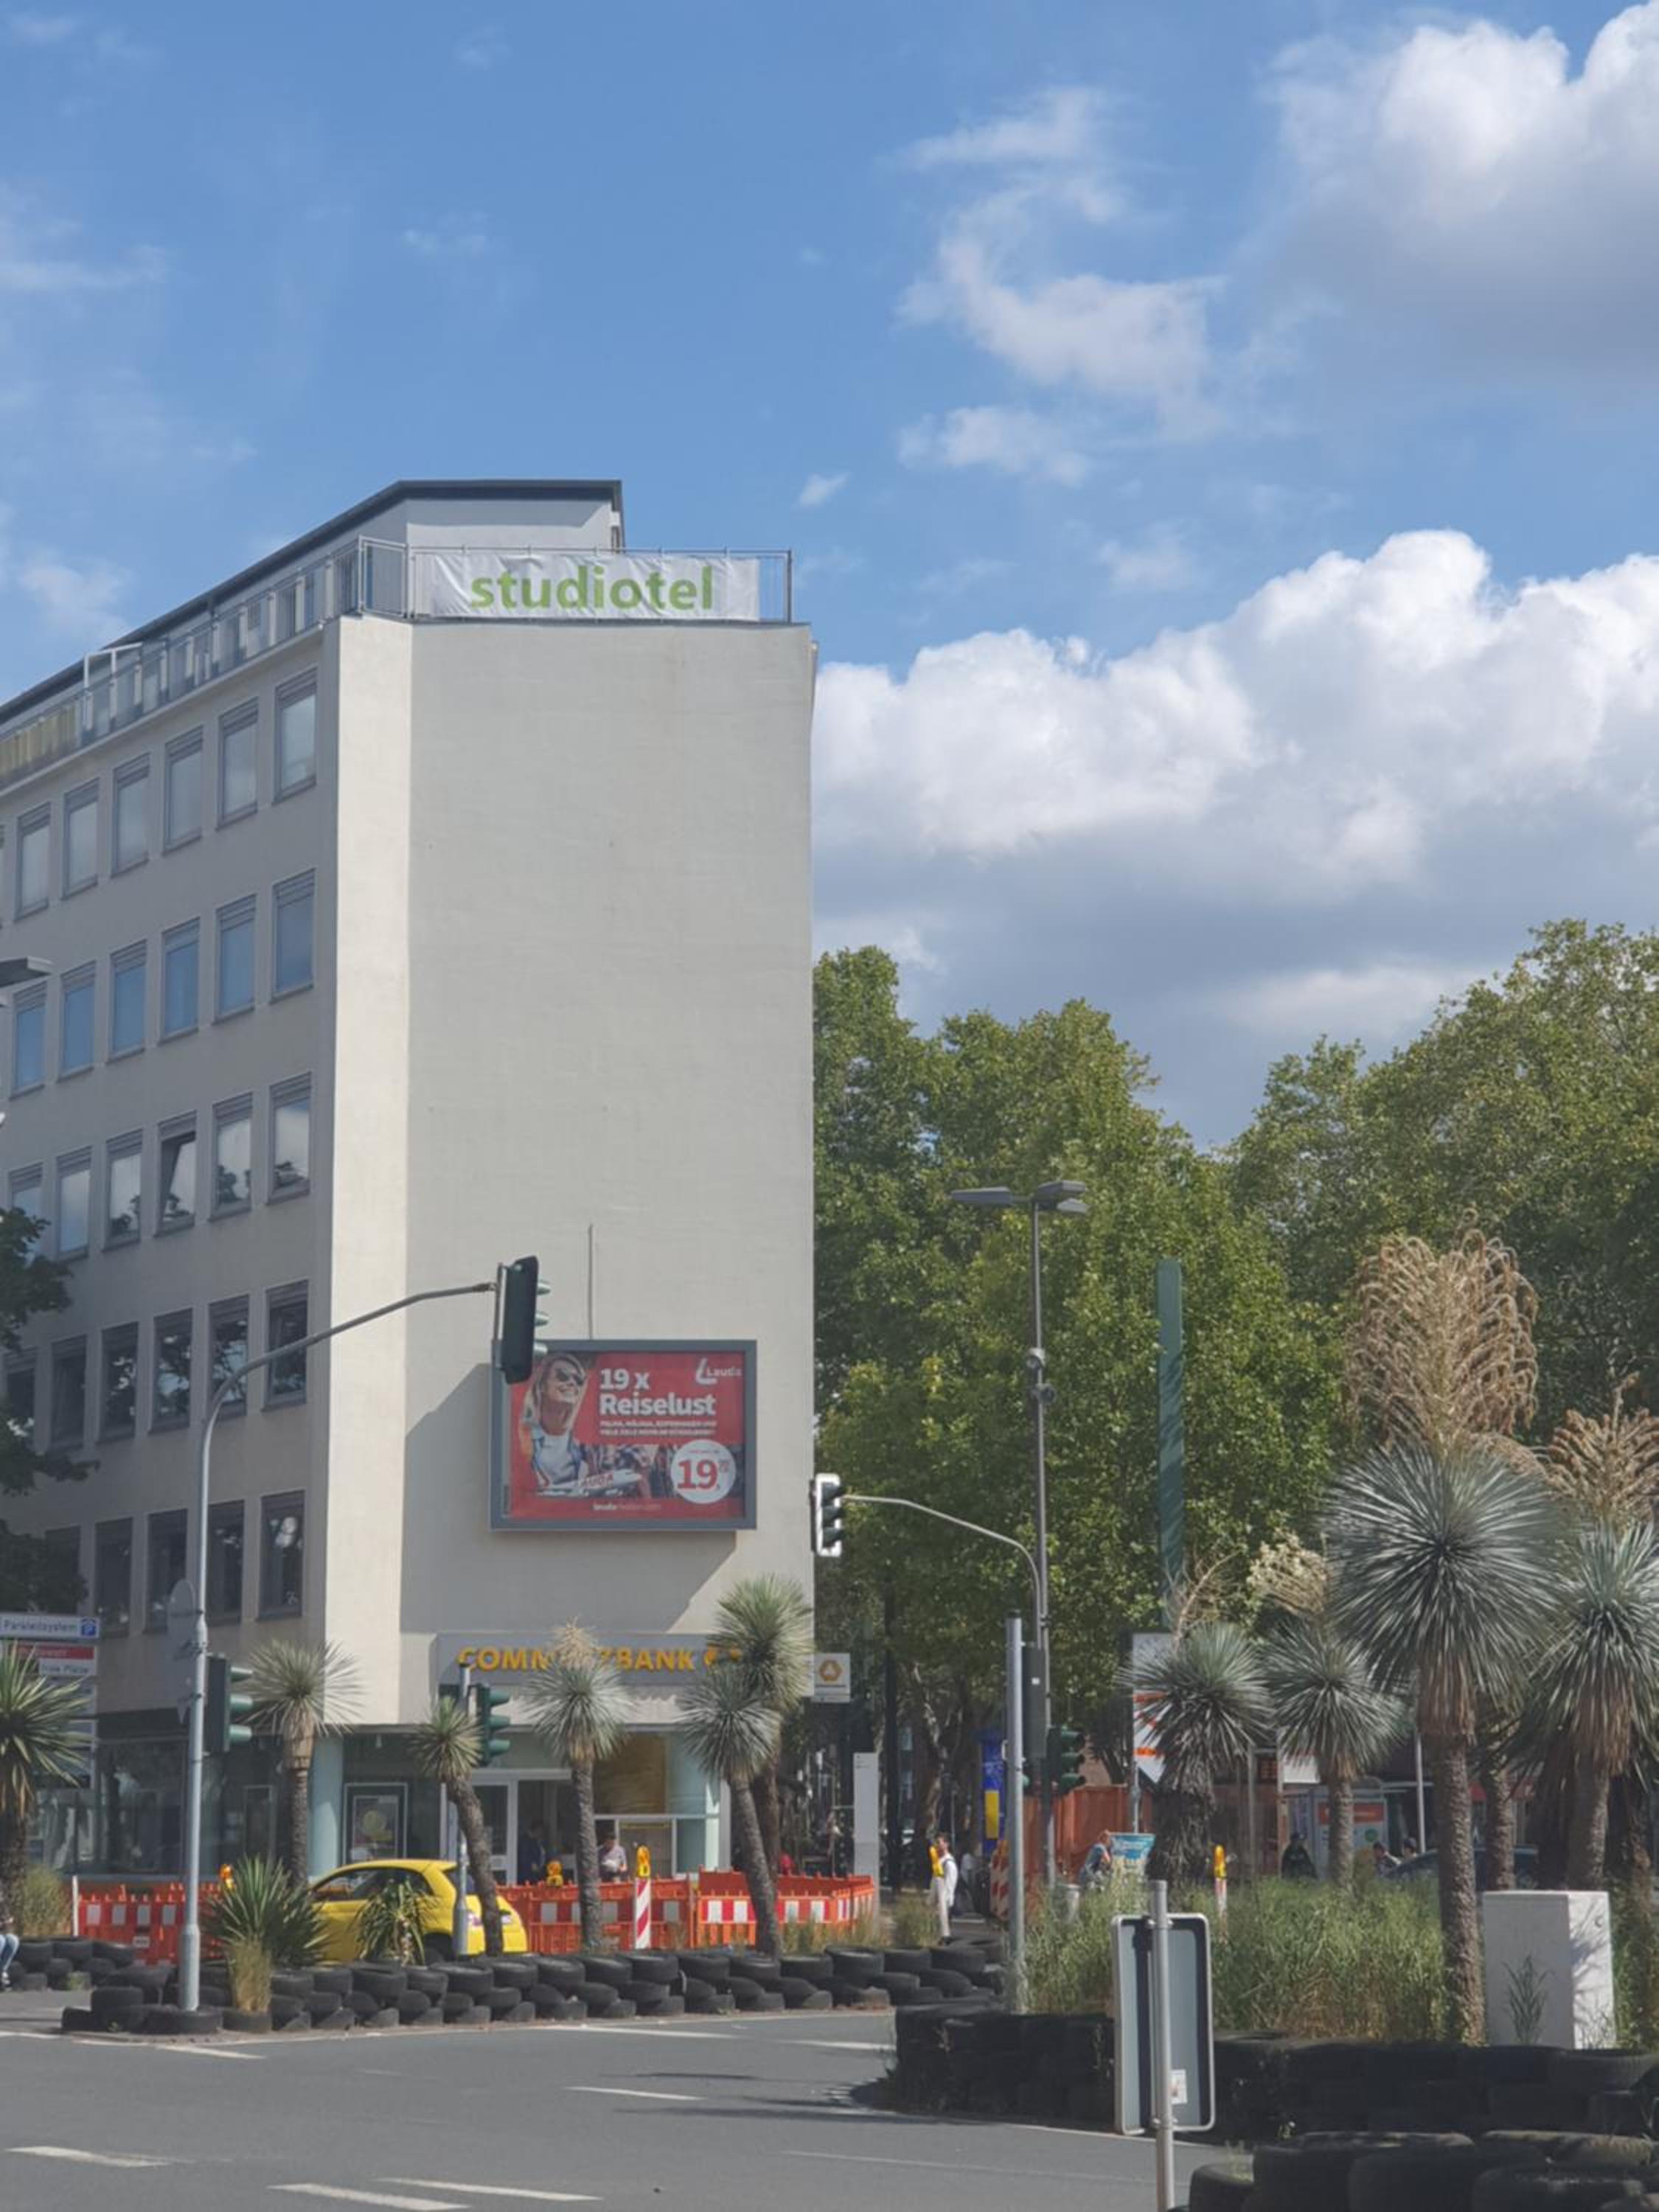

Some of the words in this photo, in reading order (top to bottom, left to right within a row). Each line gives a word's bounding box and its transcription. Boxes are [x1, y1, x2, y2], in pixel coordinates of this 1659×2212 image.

[470, 566, 713, 611] studiotel
[599, 1368, 630, 1390] 19
[634, 1372, 650, 1390] x
[599, 1391, 717, 1416] Reiselust
